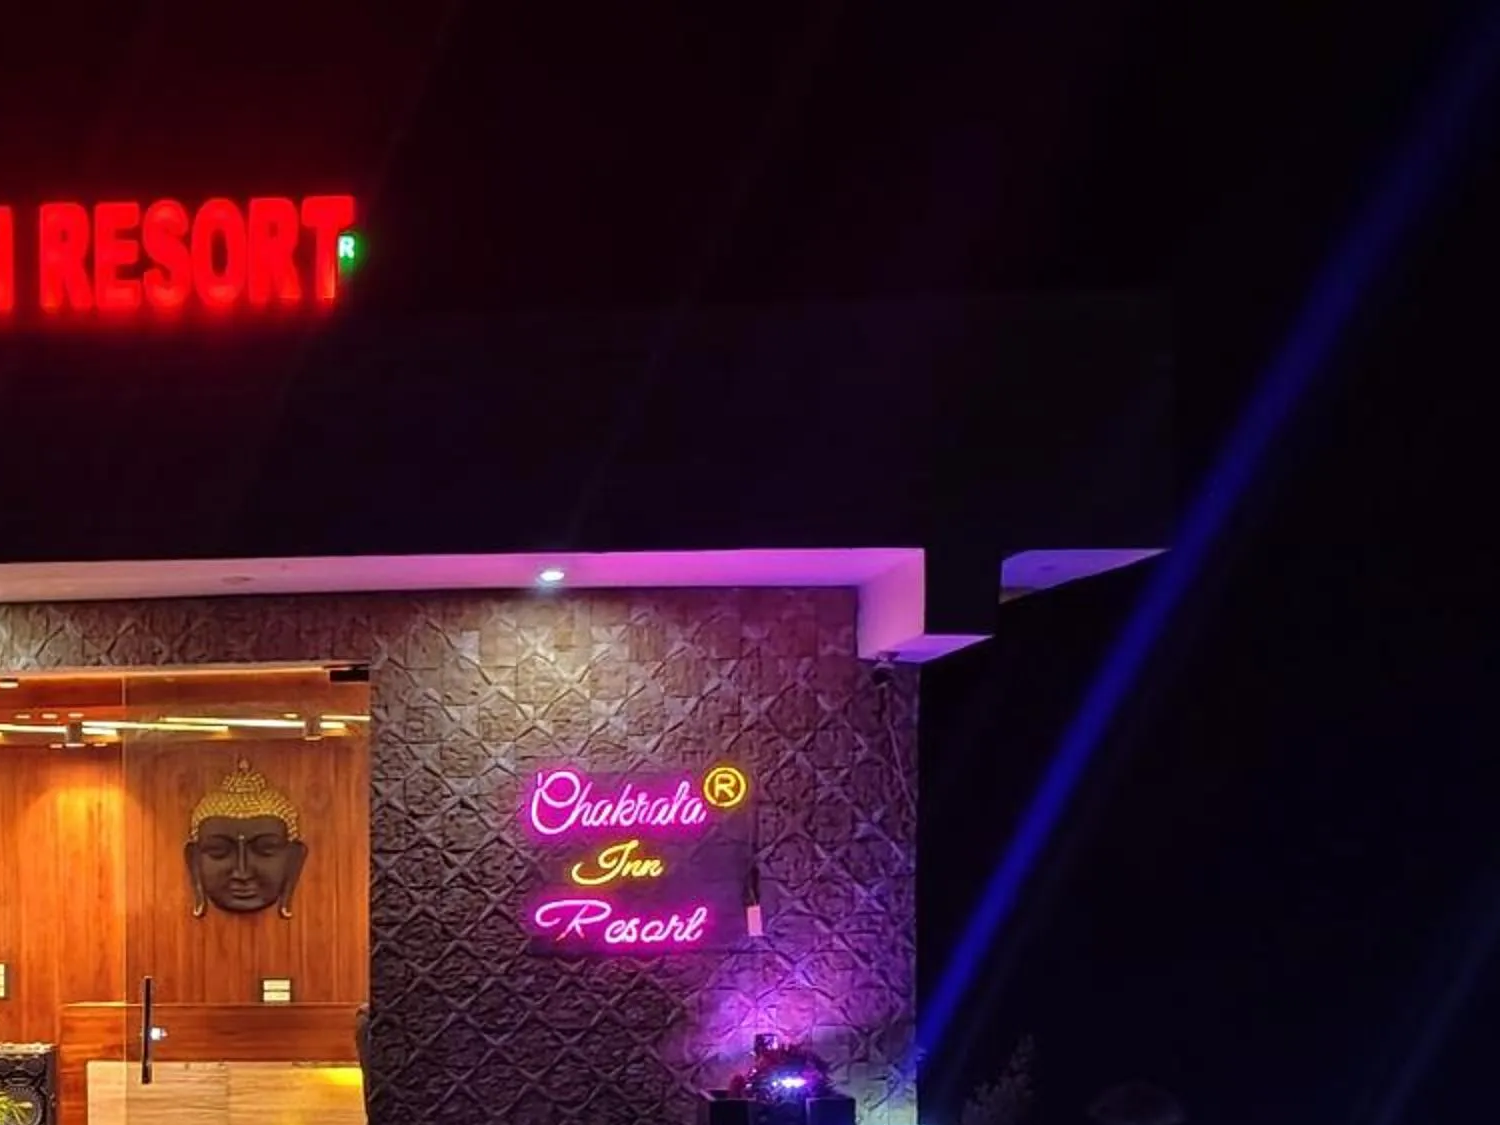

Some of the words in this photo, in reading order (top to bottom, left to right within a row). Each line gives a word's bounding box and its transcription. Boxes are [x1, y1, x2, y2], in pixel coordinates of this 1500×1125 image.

[38, 194, 356, 312] RESORT
[530, 770, 708, 835] Chakrata
[570, 839, 665, 886] Inn
[534, 899, 709, 944] Resort
